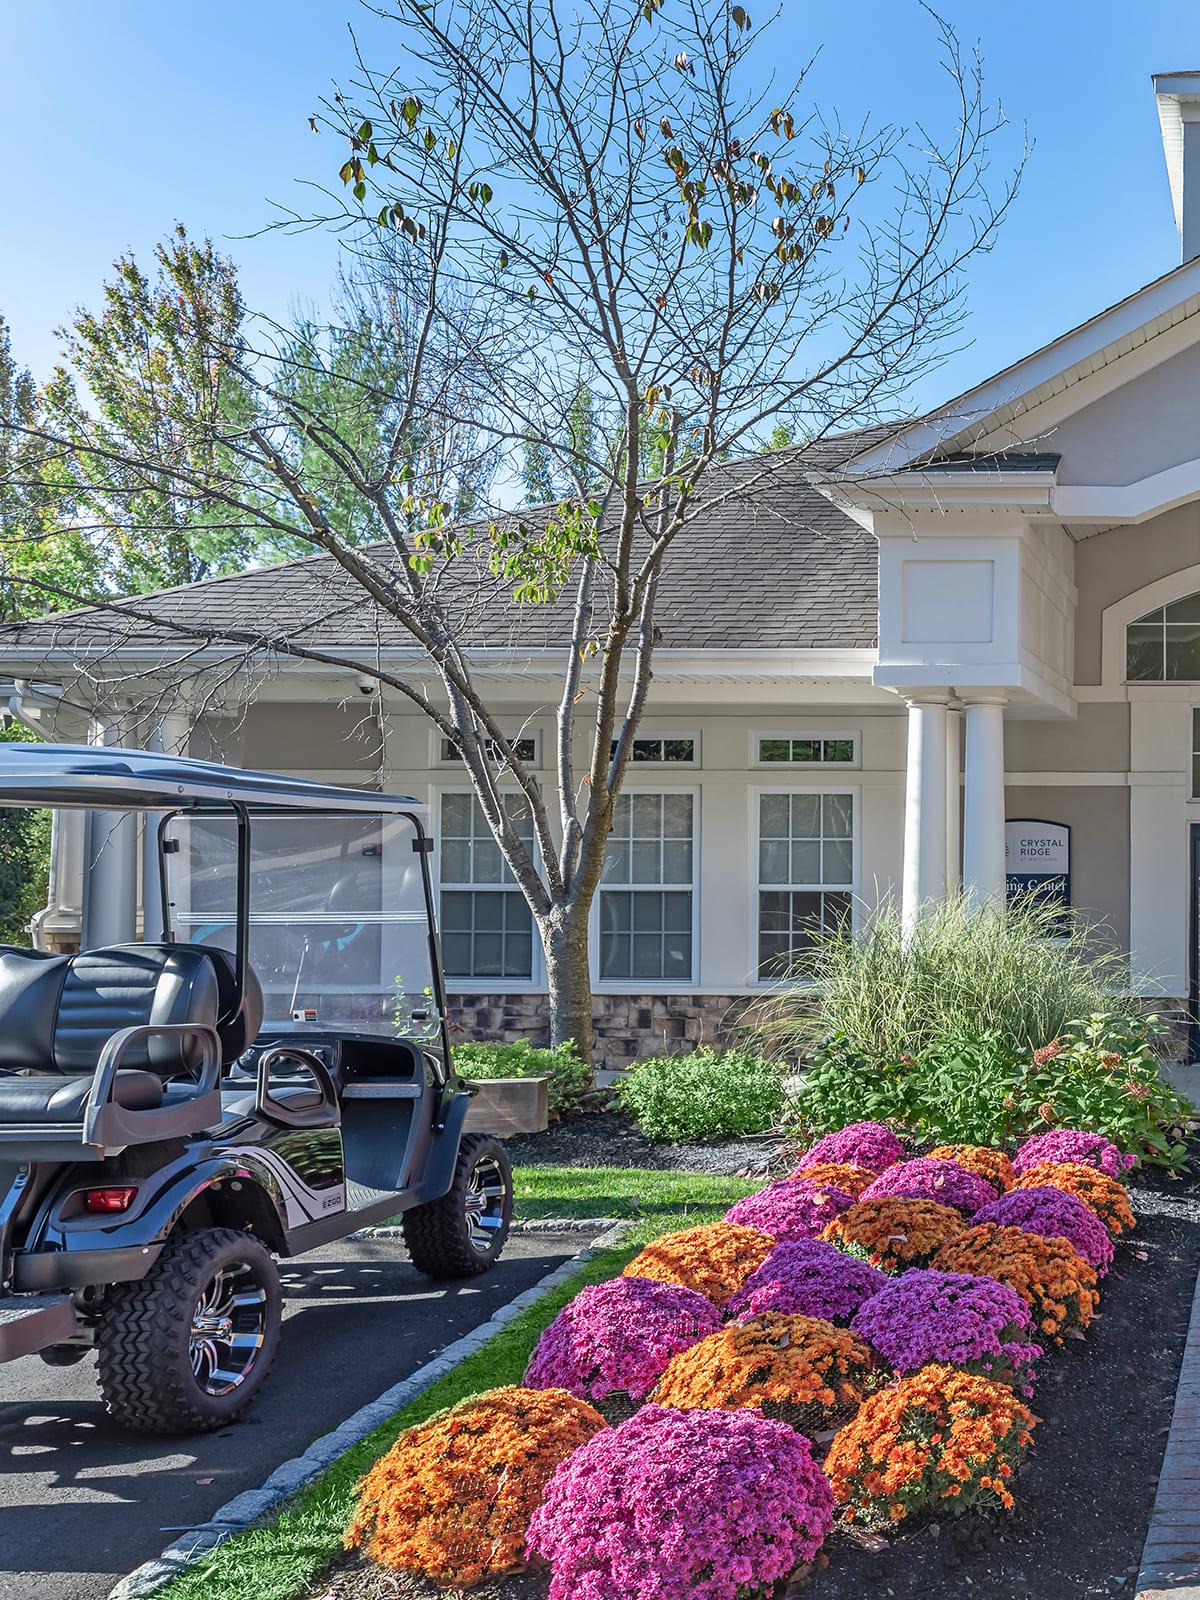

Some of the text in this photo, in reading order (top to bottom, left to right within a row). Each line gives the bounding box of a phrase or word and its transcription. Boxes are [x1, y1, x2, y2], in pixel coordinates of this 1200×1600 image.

[1020, 839, 1064, 847] CRYSTAL
[1020, 848, 1051, 856] RIDGE
[1027, 880, 1067, 891] Cnter
